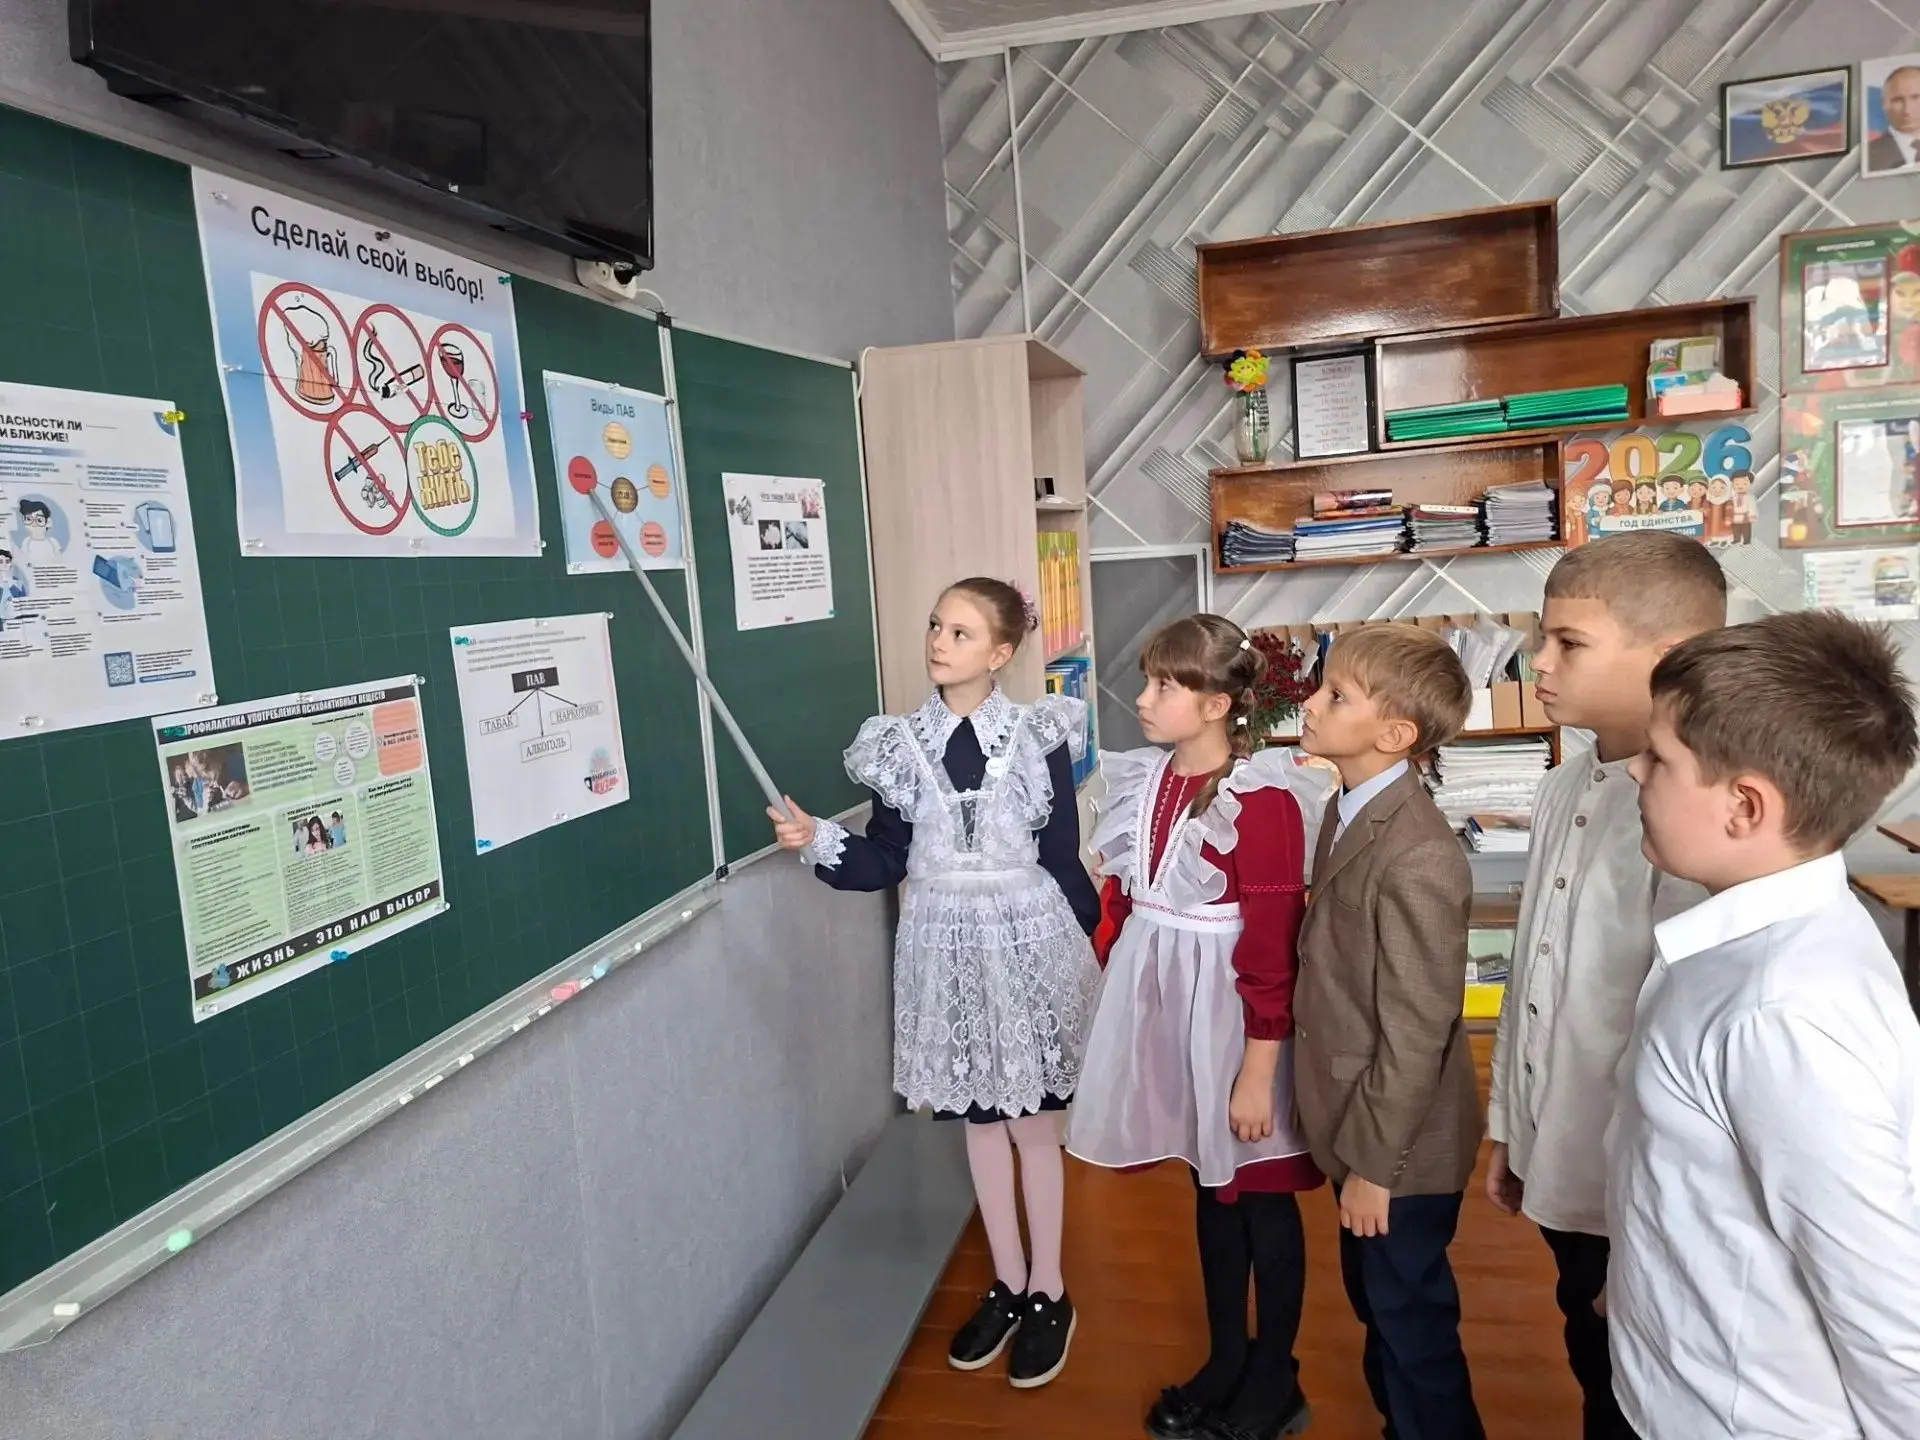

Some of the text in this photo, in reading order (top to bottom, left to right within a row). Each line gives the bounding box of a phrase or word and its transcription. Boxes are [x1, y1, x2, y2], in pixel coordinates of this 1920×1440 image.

[251, 205, 485, 303] Сделай свой выбор!
[591, 398, 636, 418] Виды ПАВ
[67, 420, 83, 431] ЛИ
[10, 428, 69, 443] БЛИЗКИЕ!
[1564, 425, 1753, 488] 2026
[1619, 514, 1694, 528] ГОД ЕДИНСТВА
[526, 672, 546, 687] ПАВ
[248, 703, 301, 725] УПОТРЕБЛЕНИЯ
[301, 693, 358, 714] ПСИХОАКТИВНЫХ
[358, 690, 386, 705] ВЕЩЕСТВ
[556, 703, 599, 722] НАРКОТИКИ
[484, 716, 514, 733] ТАБАК
[526, 738, 567, 757] АЛКОГОЛЬ
[236, 945, 295, 979] ЖИЗНЬ
[316, 924, 343, 945] ЭТО
[350, 908, 381, 930] НАШ
[386, 887, 431, 915] ВЫБОР
